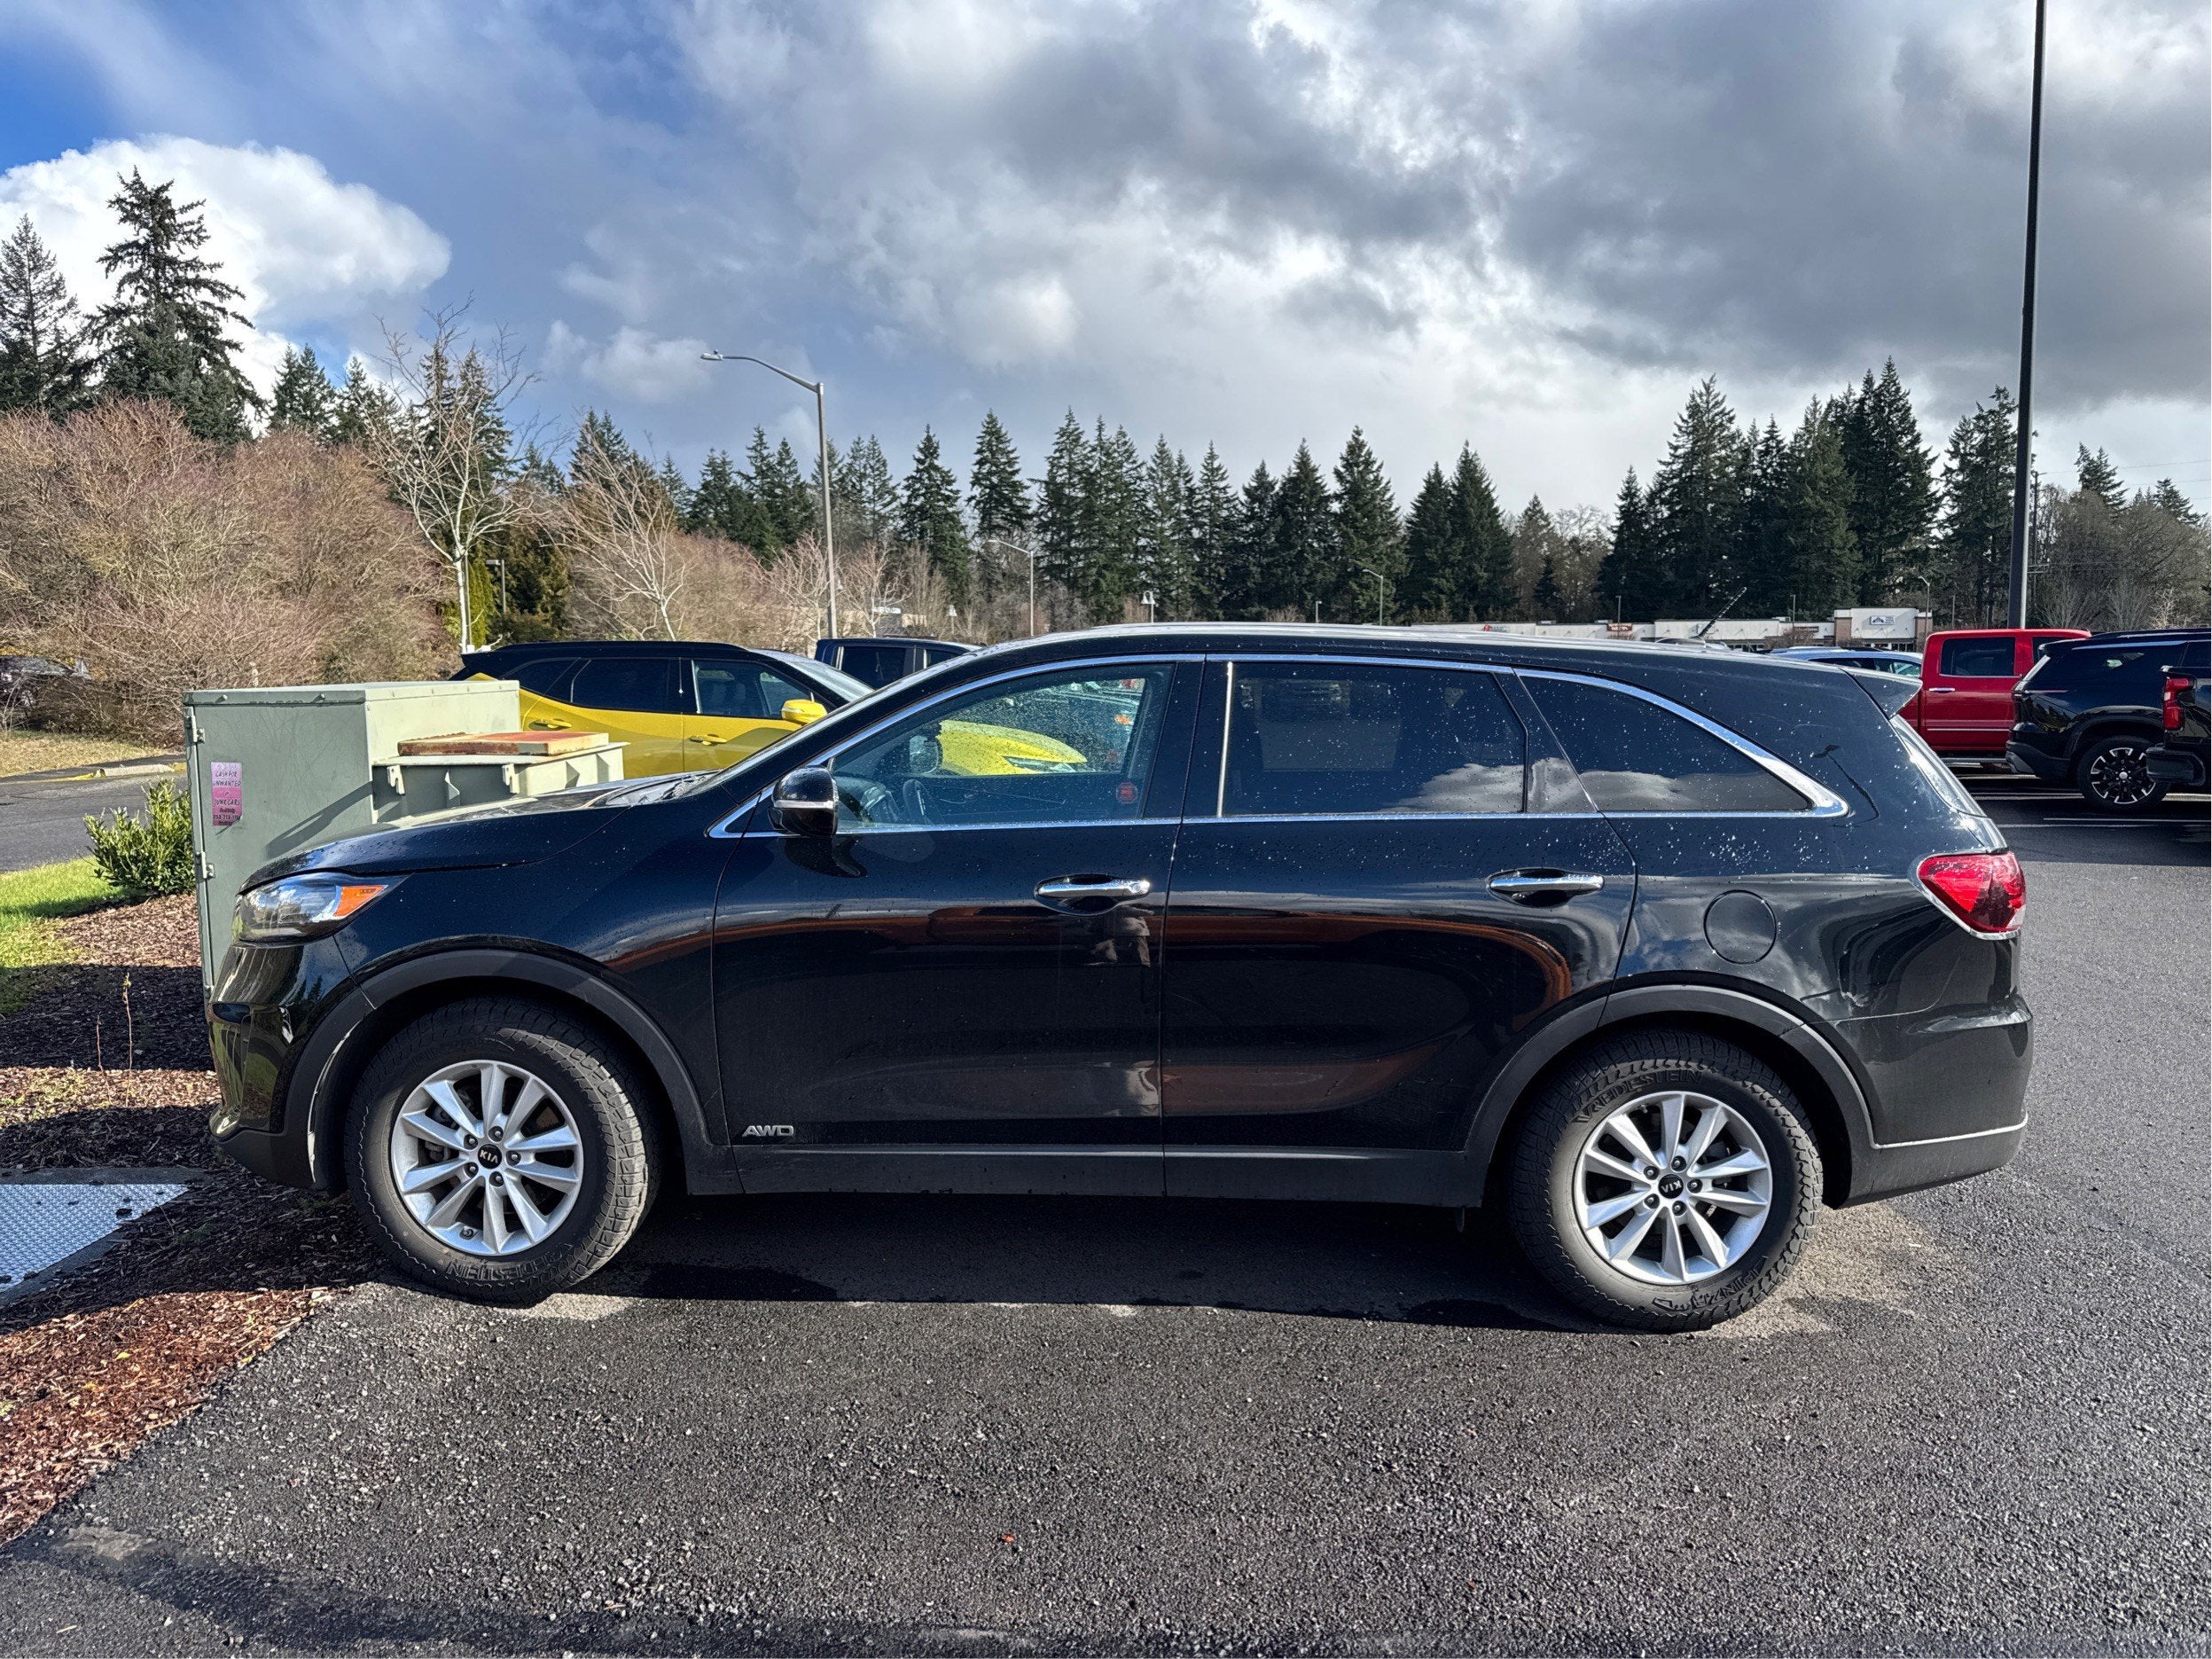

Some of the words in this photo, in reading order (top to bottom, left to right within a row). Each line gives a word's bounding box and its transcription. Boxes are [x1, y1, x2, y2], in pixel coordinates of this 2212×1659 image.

[1572, 1069, 1703, 1123] VREDESTEIN
[741, 1124, 794, 1138] AWD
[480, 1149, 498, 1163] KIA
[1661, 1180, 1682, 1193] KIA
